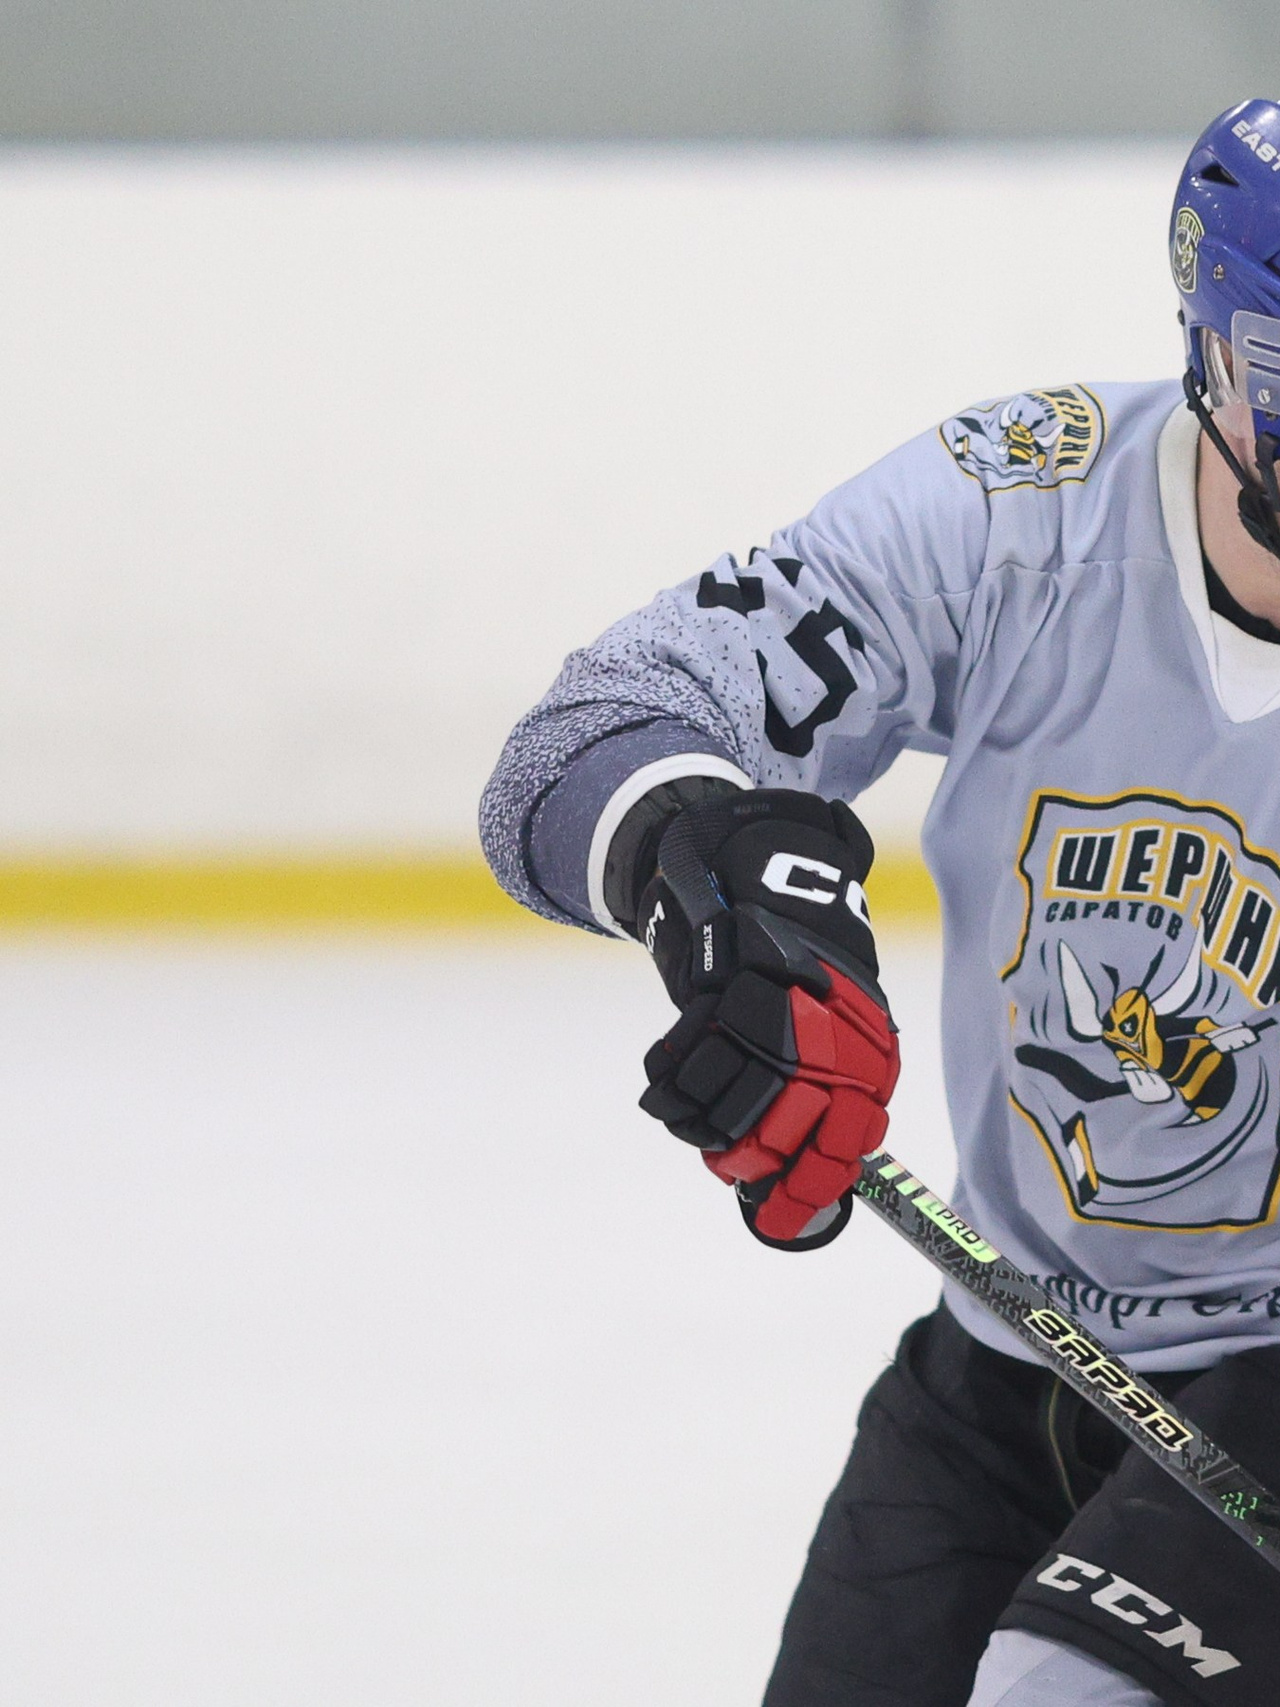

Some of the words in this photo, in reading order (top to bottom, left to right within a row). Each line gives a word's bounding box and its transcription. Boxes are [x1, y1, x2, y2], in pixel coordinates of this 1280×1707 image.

[703, 924, 714, 972] JETSPEED
[1045, 900, 1184, 942] САРАТОВ
[1022, 1308, 1194, 1453] ЗАРЯД
[1036, 1553, 1242, 1679] CCM
